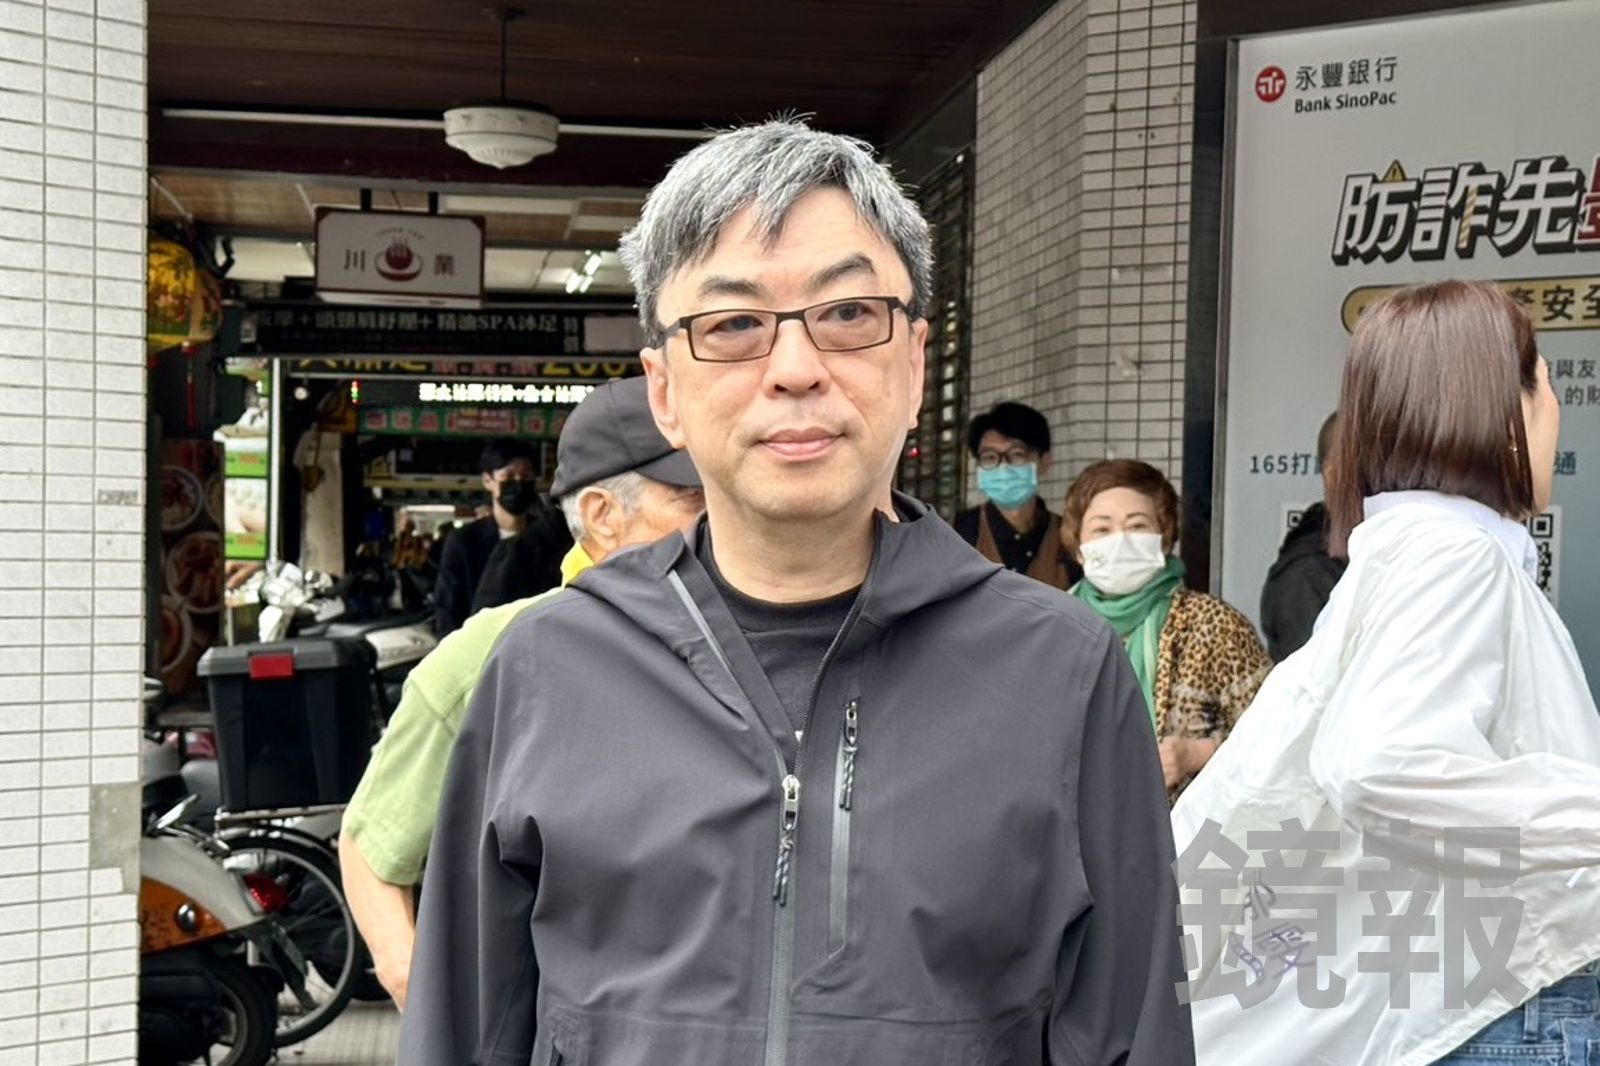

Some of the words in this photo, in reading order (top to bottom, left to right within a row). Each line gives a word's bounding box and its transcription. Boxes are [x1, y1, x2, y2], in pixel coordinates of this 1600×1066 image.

[1295, 56, 1398, 91] 永豐銀行
[1294, 98, 1332, 113] Bank
[1336, 91, 1397, 110] SinoPac
